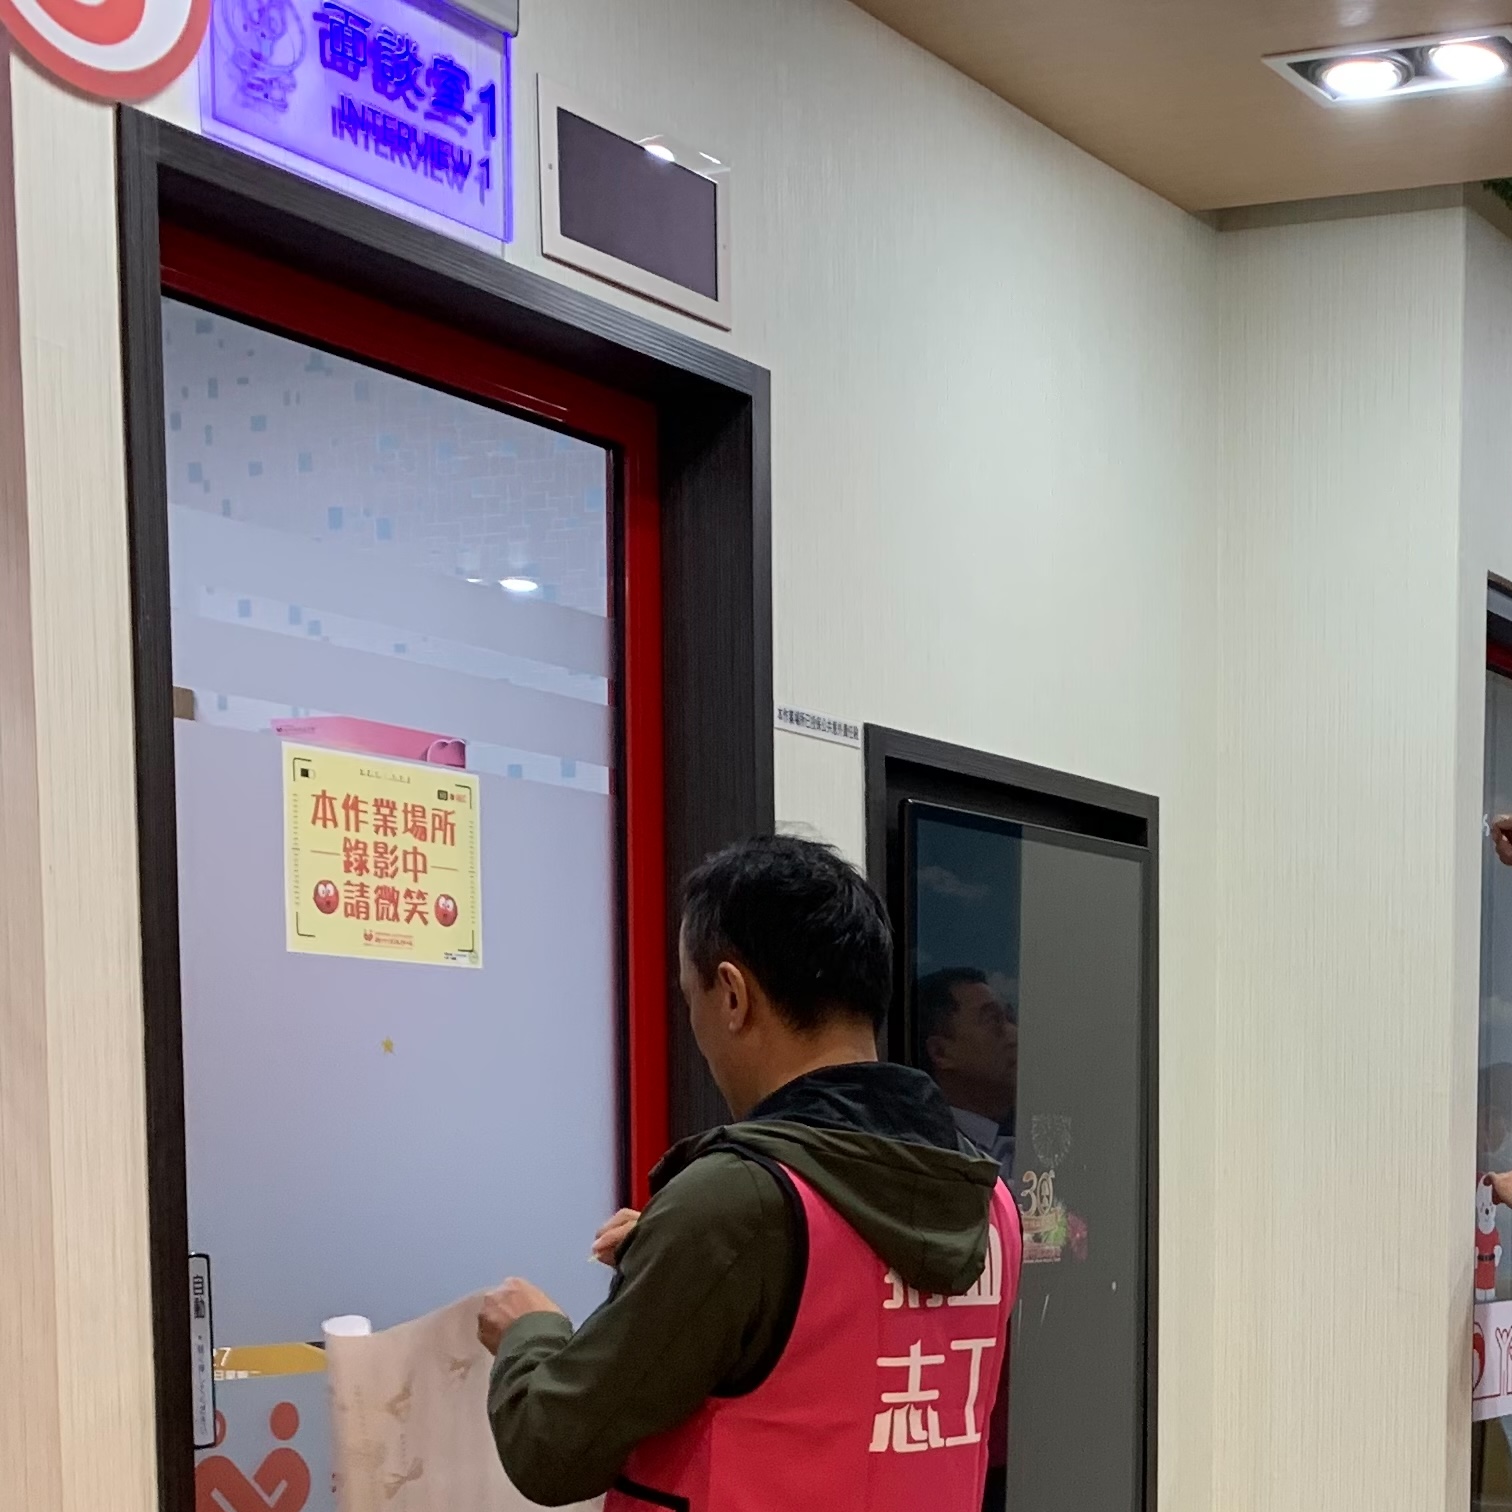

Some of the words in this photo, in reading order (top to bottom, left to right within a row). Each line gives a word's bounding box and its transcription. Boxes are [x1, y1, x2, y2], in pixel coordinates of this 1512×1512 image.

[335, 93, 472, 186] INTERVIEW
[310, 789, 456, 847] 本作業場所
[342, 836, 428, 883] 錄影中
[343, 880, 429, 927] 請微笑
[868, 1338, 997, 1453] 志工
